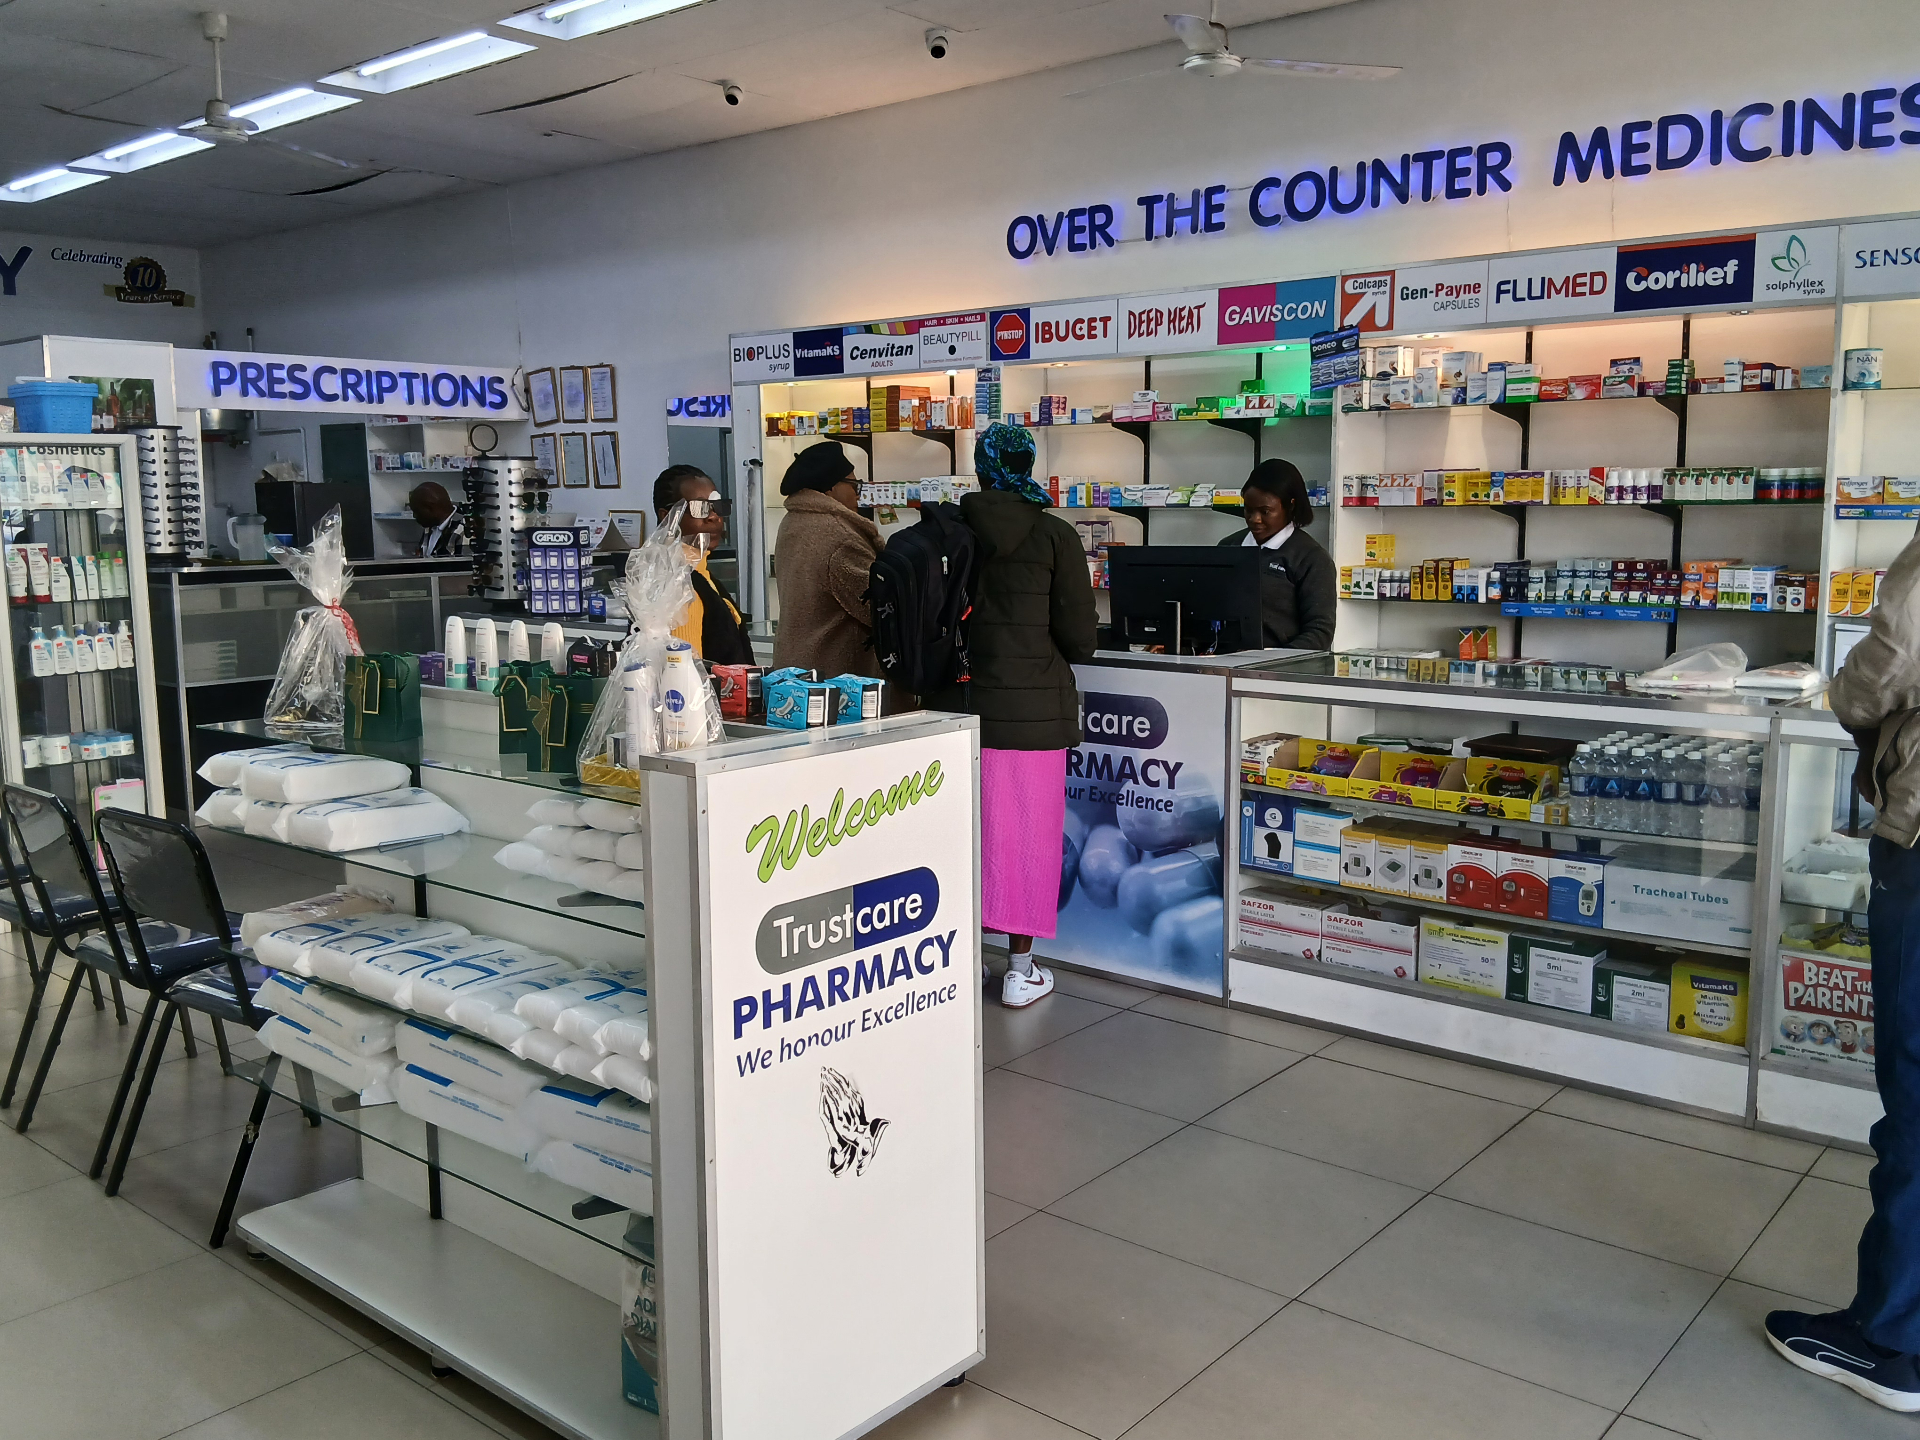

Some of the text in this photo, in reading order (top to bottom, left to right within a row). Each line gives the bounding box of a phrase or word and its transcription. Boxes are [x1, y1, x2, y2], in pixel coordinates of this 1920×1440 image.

[1007, 82, 1920, 259] OVER THE COUNTER MEDICINES
[51, 247, 124, 268] Celebrating
[135, 267, 157, 288] 10
[1352, 277, 1388, 292] Colcaps
[1626, 258, 1739, 292] Corilief
[1765, 277, 1824, 293] solphyllex
[120, 292, 141, 301] Years
[1372, 290, 1388, 298] syrup
[1400, 280, 1482, 301] Gen-Payne
[1496, 270, 1608, 304] FLUMED
[1802, 287, 1826, 296] syrup
[1224, 299, 1326, 327] GAVISCON
[1433, 298, 1480, 312] CAPSULES
[964, 314, 981, 322] NAILS
[1127, 302, 1207, 340] DEEP HEAT
[923, 330, 982, 346] BEAUTYPILL
[1312, 341, 1337, 352] DORCO
[733, 343, 790, 363] BIOPLUS
[850, 341, 913, 361] Cenvitan
[1856, 355, 1878, 364] NAN
[768, 362, 790, 372] syrup
[870, 359, 894, 368] ADULTS
[210, 360, 509, 410] PRESCRIPTIONS
[536, 534, 569, 543] CAFLON
[1065, 748, 1184, 790] RMACY
[1088, 786, 1174, 813] Excellence
[745, 759, 944, 883] Welcome
[1633, 884, 1729, 905] Tracheal Tubes
[1241, 899, 1275, 912] SAFZOR
[773, 890, 923, 959] Trustcare
[1326, 914, 1363, 928] SAFZOR
[733, 929, 958, 1040] PHARMACY
[1803, 961, 1872, 994] BEAT TH
[1631, 989, 1645, 998] 2ml
[736, 982, 958, 1077] We honour Excellence
